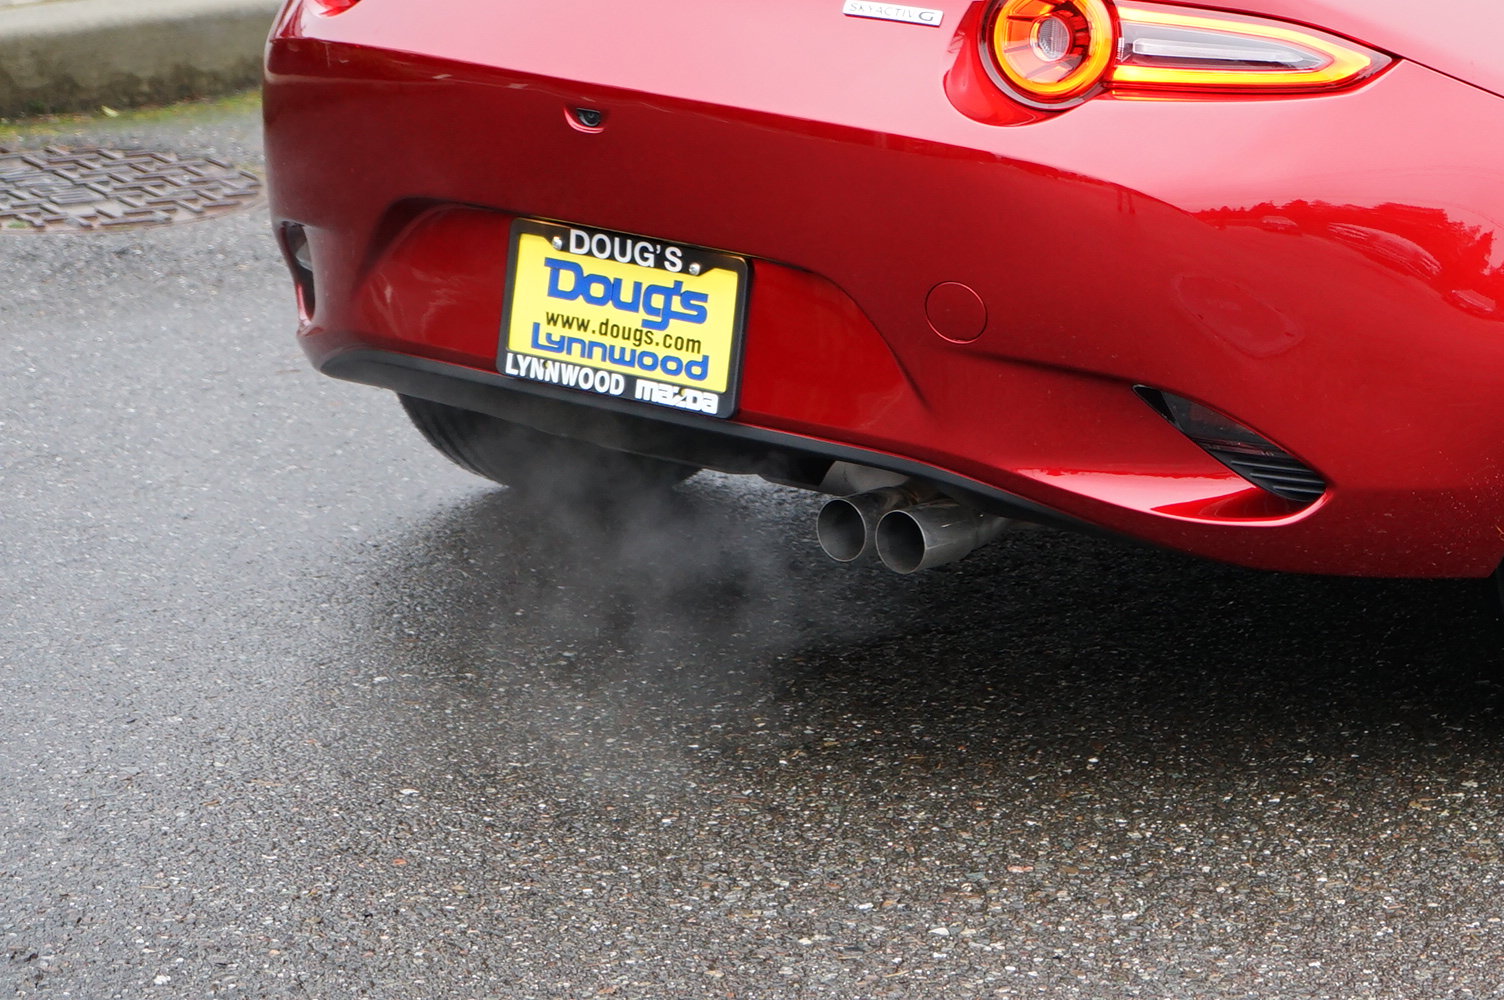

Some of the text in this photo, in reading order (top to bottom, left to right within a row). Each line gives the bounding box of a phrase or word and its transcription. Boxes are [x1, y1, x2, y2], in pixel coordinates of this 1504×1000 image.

[918, 11, 936, 22] G
[569, 229, 683, 273] DOUG'S
[531, 322, 710, 381] Lynnwood
[545, 311, 702, 354] www.dougs.com
[505, 352, 625, 396] LYNNWOOD
